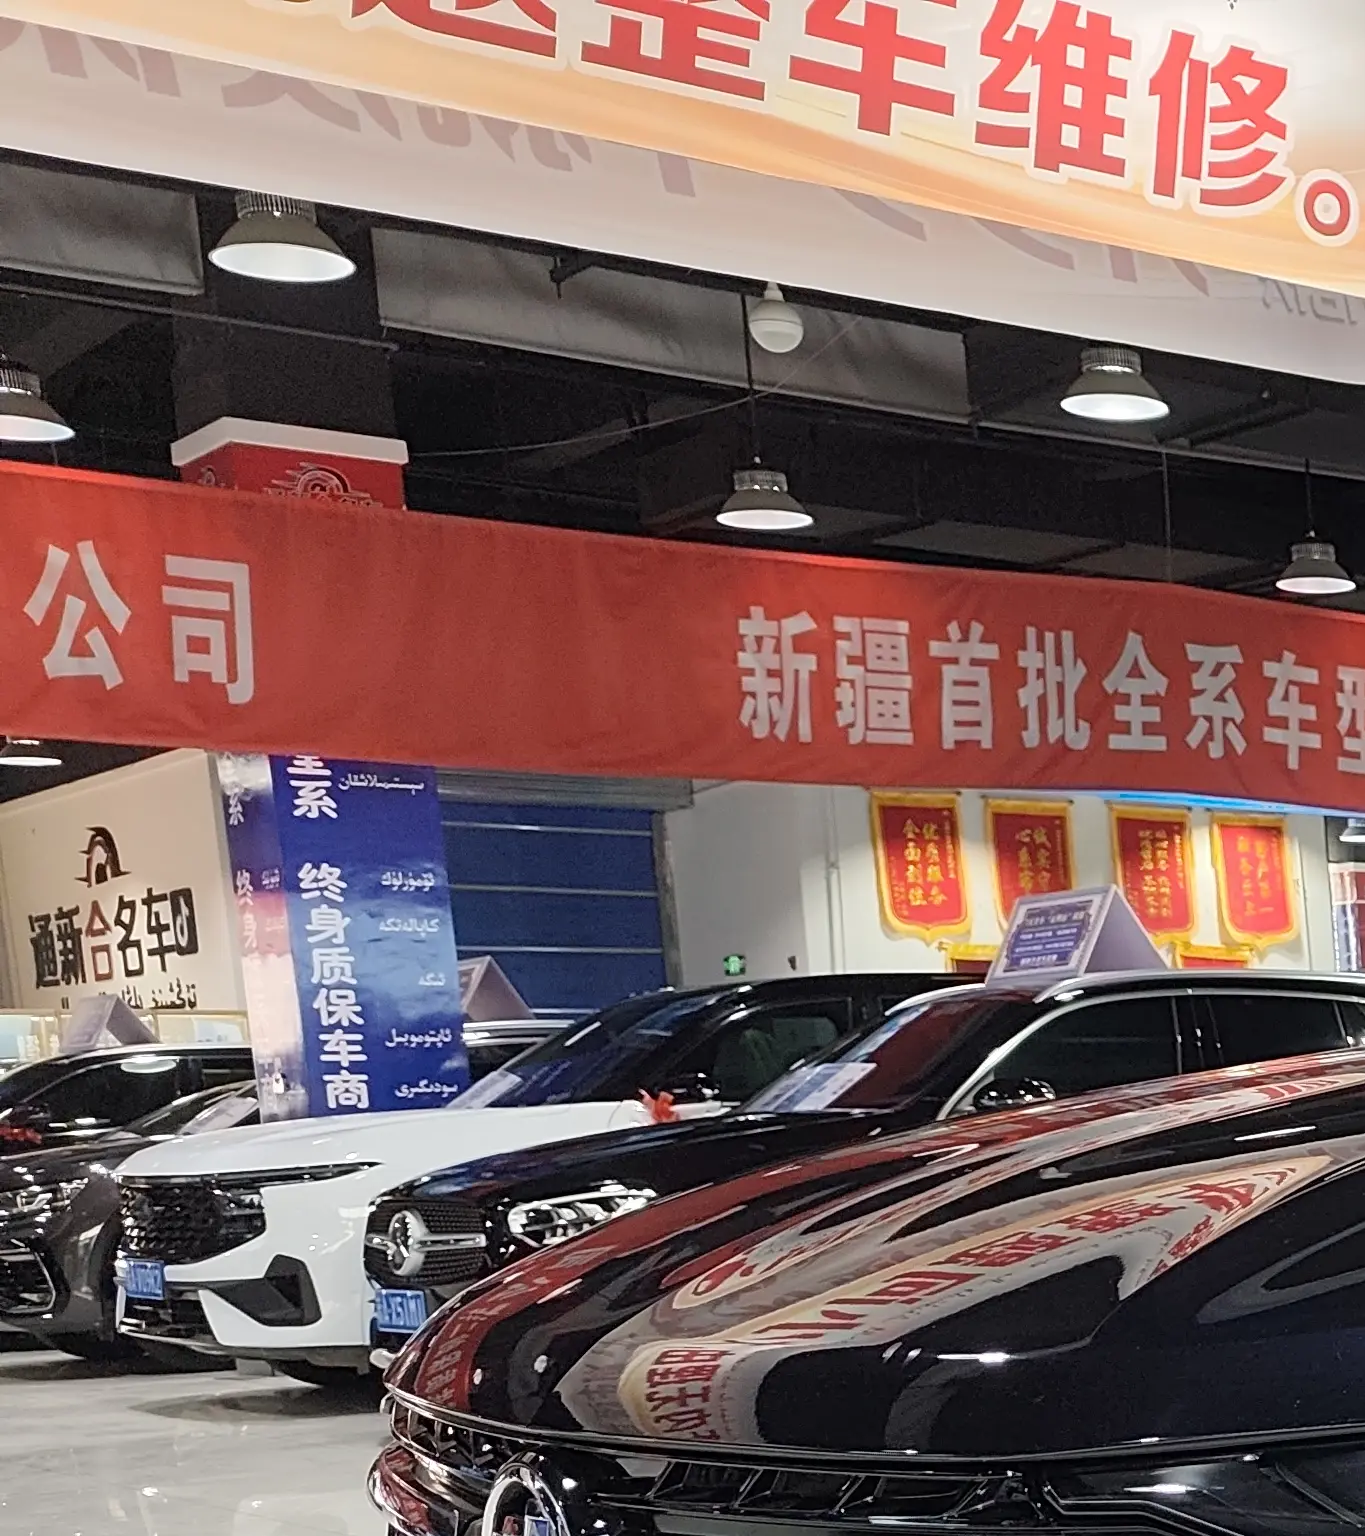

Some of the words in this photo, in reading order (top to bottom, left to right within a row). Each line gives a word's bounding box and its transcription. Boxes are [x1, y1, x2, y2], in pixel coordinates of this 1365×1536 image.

[23, 538, 256, 706] 公司
[297, 861, 370, 1110] 终身质保车商
